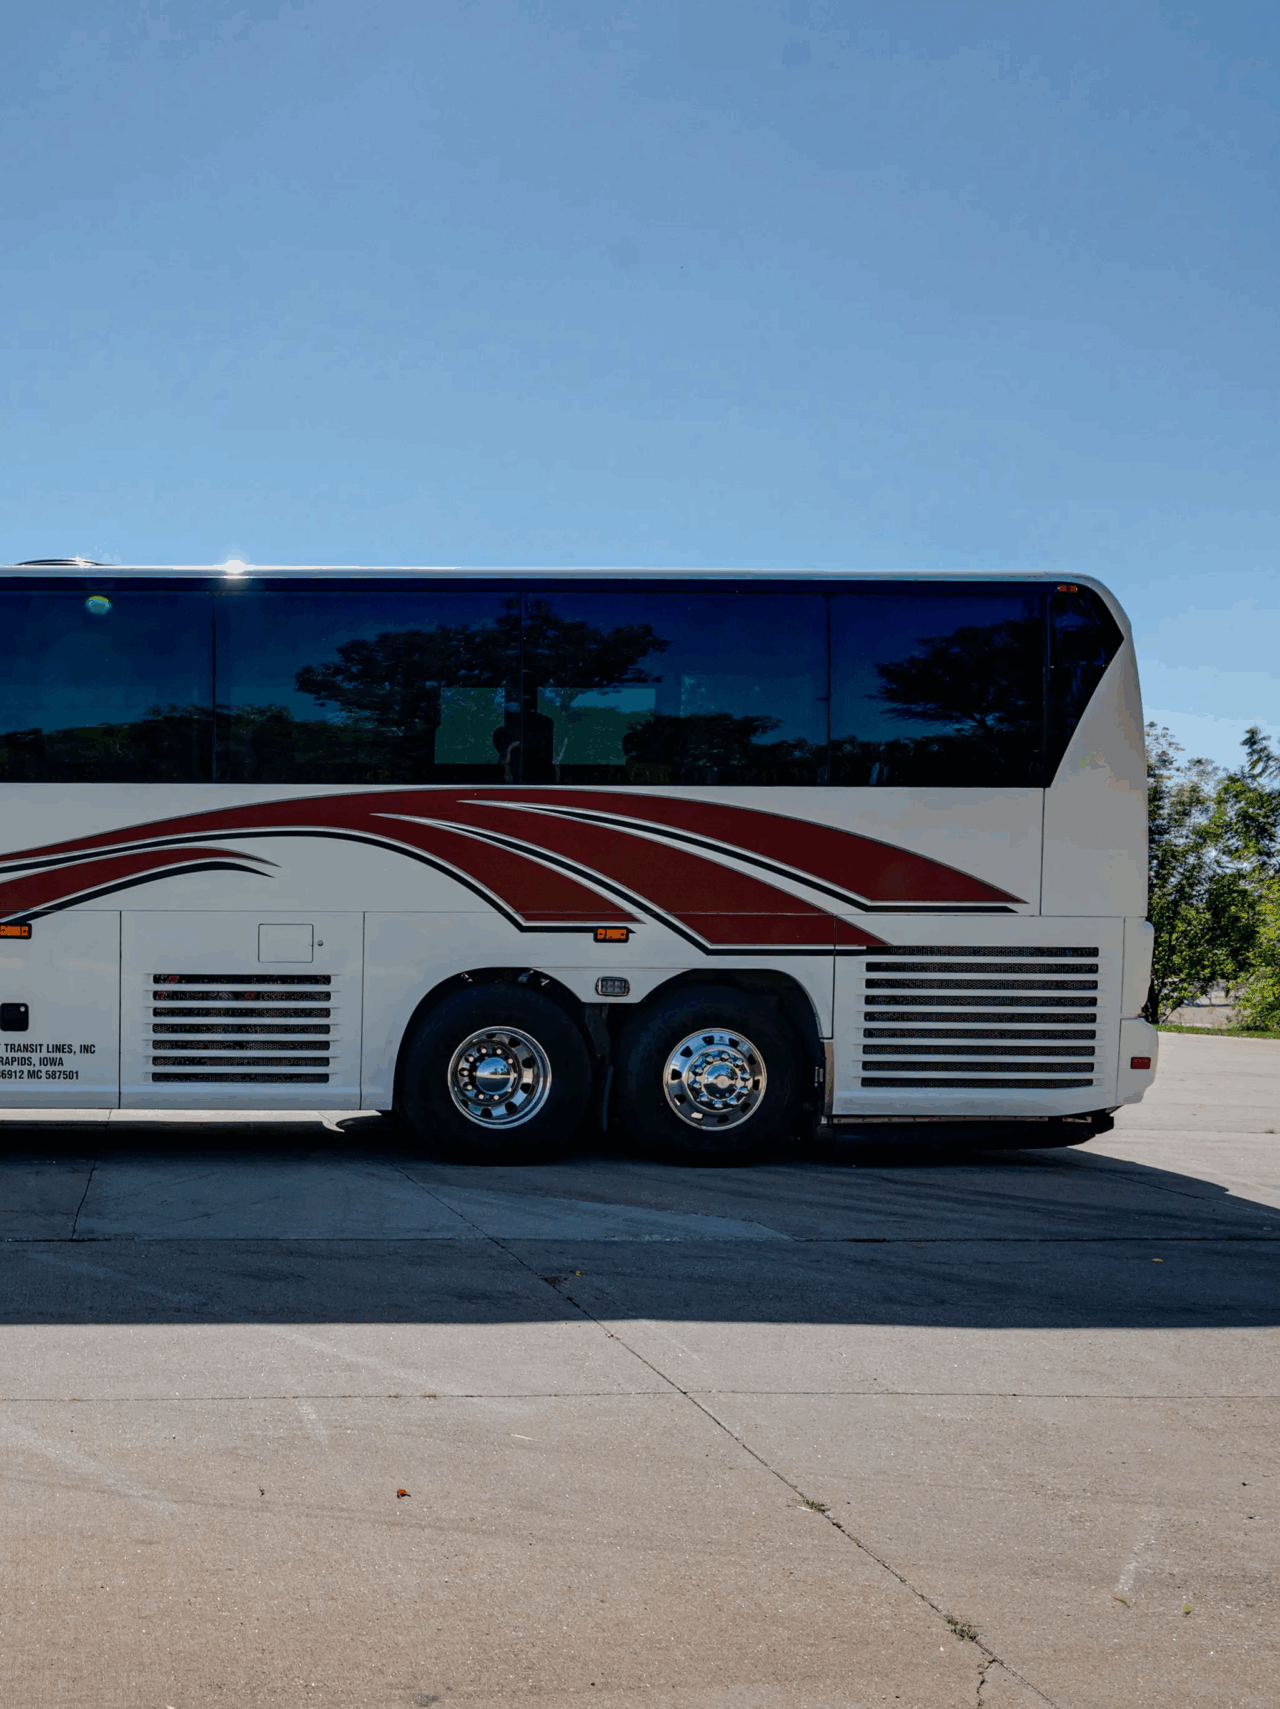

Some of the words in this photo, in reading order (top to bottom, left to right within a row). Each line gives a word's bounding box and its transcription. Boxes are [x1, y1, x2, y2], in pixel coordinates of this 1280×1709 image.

[4, 1043, 43, 1054] TRANSIT
[46, 1044, 76, 1055] LINES,
[79, 1044, 96, 1054] INC
[39, 1057, 64, 1067] IOWA
[27, 1070, 43, 1080] MC
[45, 1070, 79, 1080] 587501
